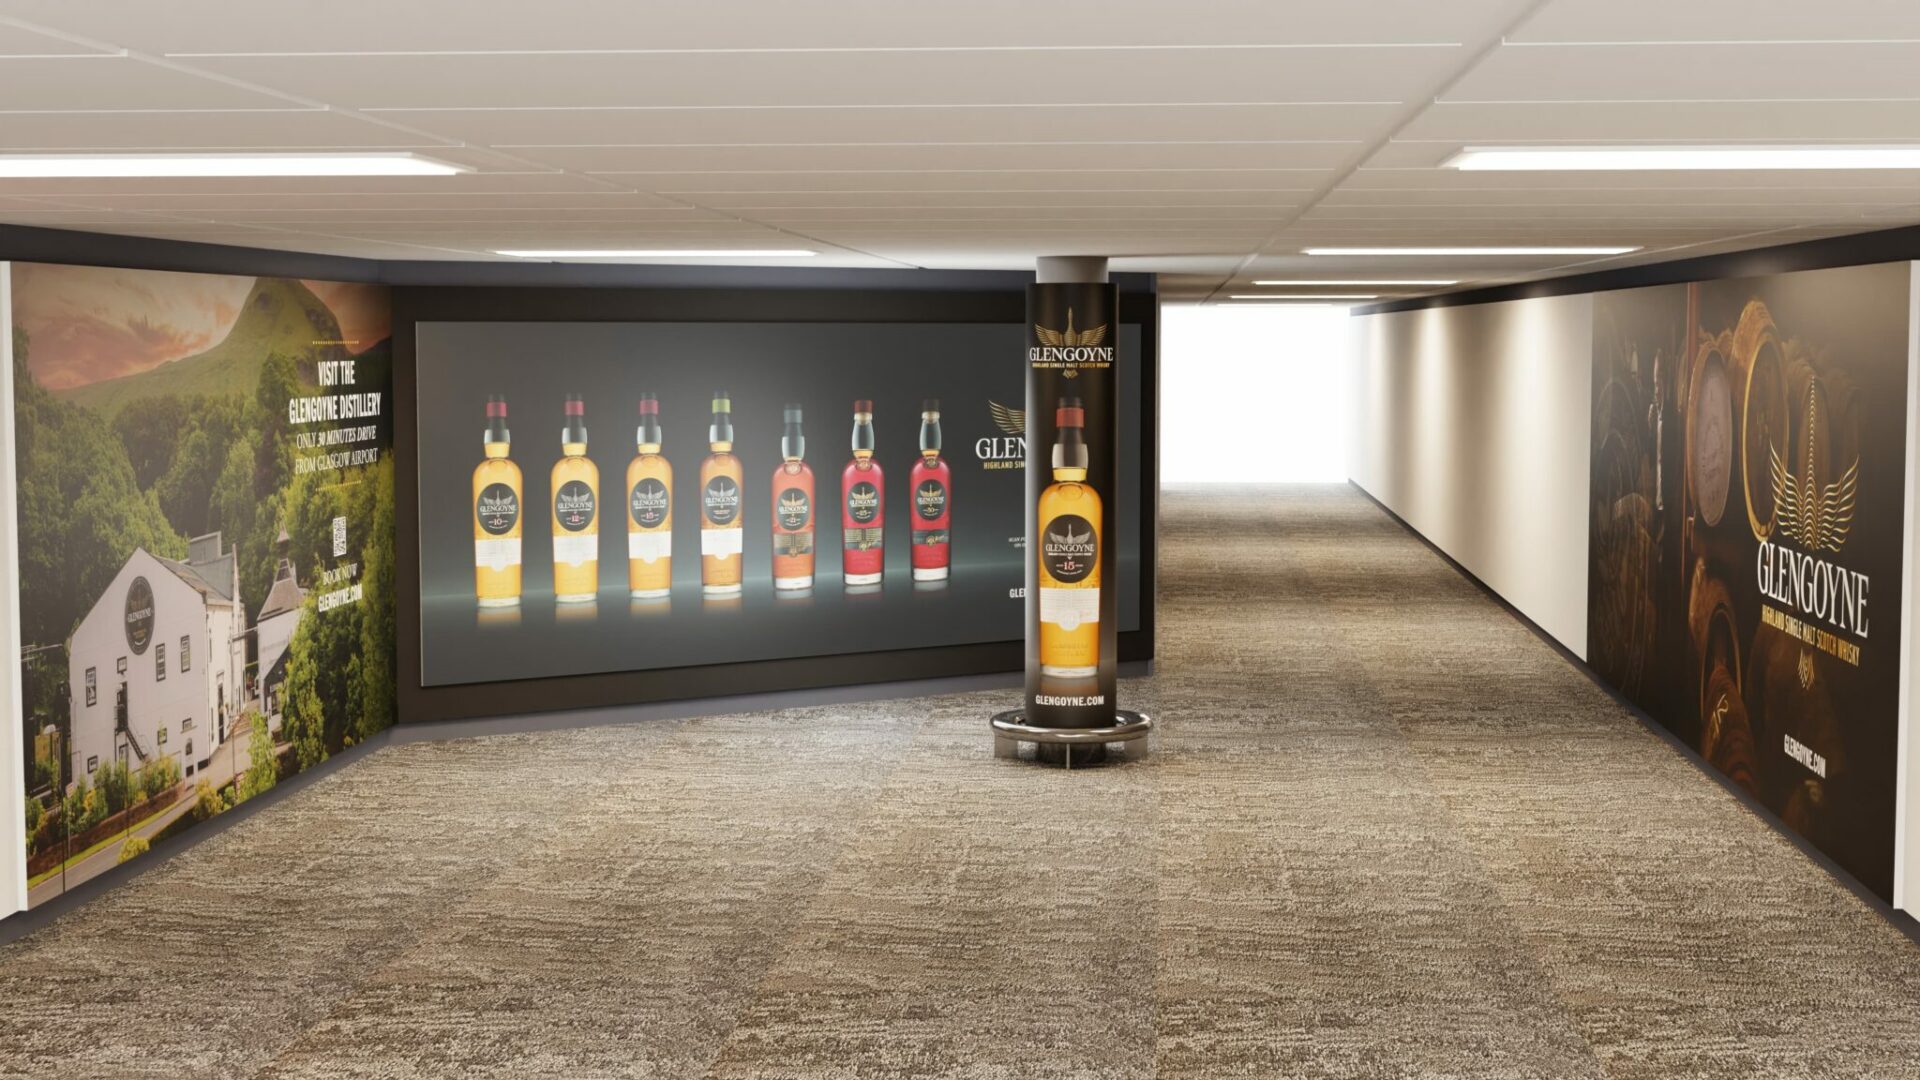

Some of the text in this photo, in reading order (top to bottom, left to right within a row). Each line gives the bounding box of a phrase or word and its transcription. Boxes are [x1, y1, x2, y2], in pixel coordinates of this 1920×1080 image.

[1029, 347, 1114, 362] GLENGOYNE
[318, 360, 355, 386] VISIT THE
[289, 392, 382, 424] GLENGOYNE DISTILLERY
[296, 420, 377, 449] ONLY 30 MINUTES DRIVE
[295, 447, 378, 475] FROM GLASGOW AIRPORT
[983, 461, 1014, 470] HIGHLAND
[1045, 543, 1095, 552] GLENGOYNE
[322, 562, 358, 586] BOOK NOW
[1064, 561, 1075, 571] 15
[318, 583, 363, 613] GLENGOYNE.COM
[1757, 539, 1869, 639] GLENGOYNE
[1762, 603, 1860, 667] HIGHLAND SINGLE MALT SCOTCH WHISKY
[1035, 694, 1105, 707] GLENGOYNE.COM
[1784, 733, 1826, 779] GLENGOYNE.COM
